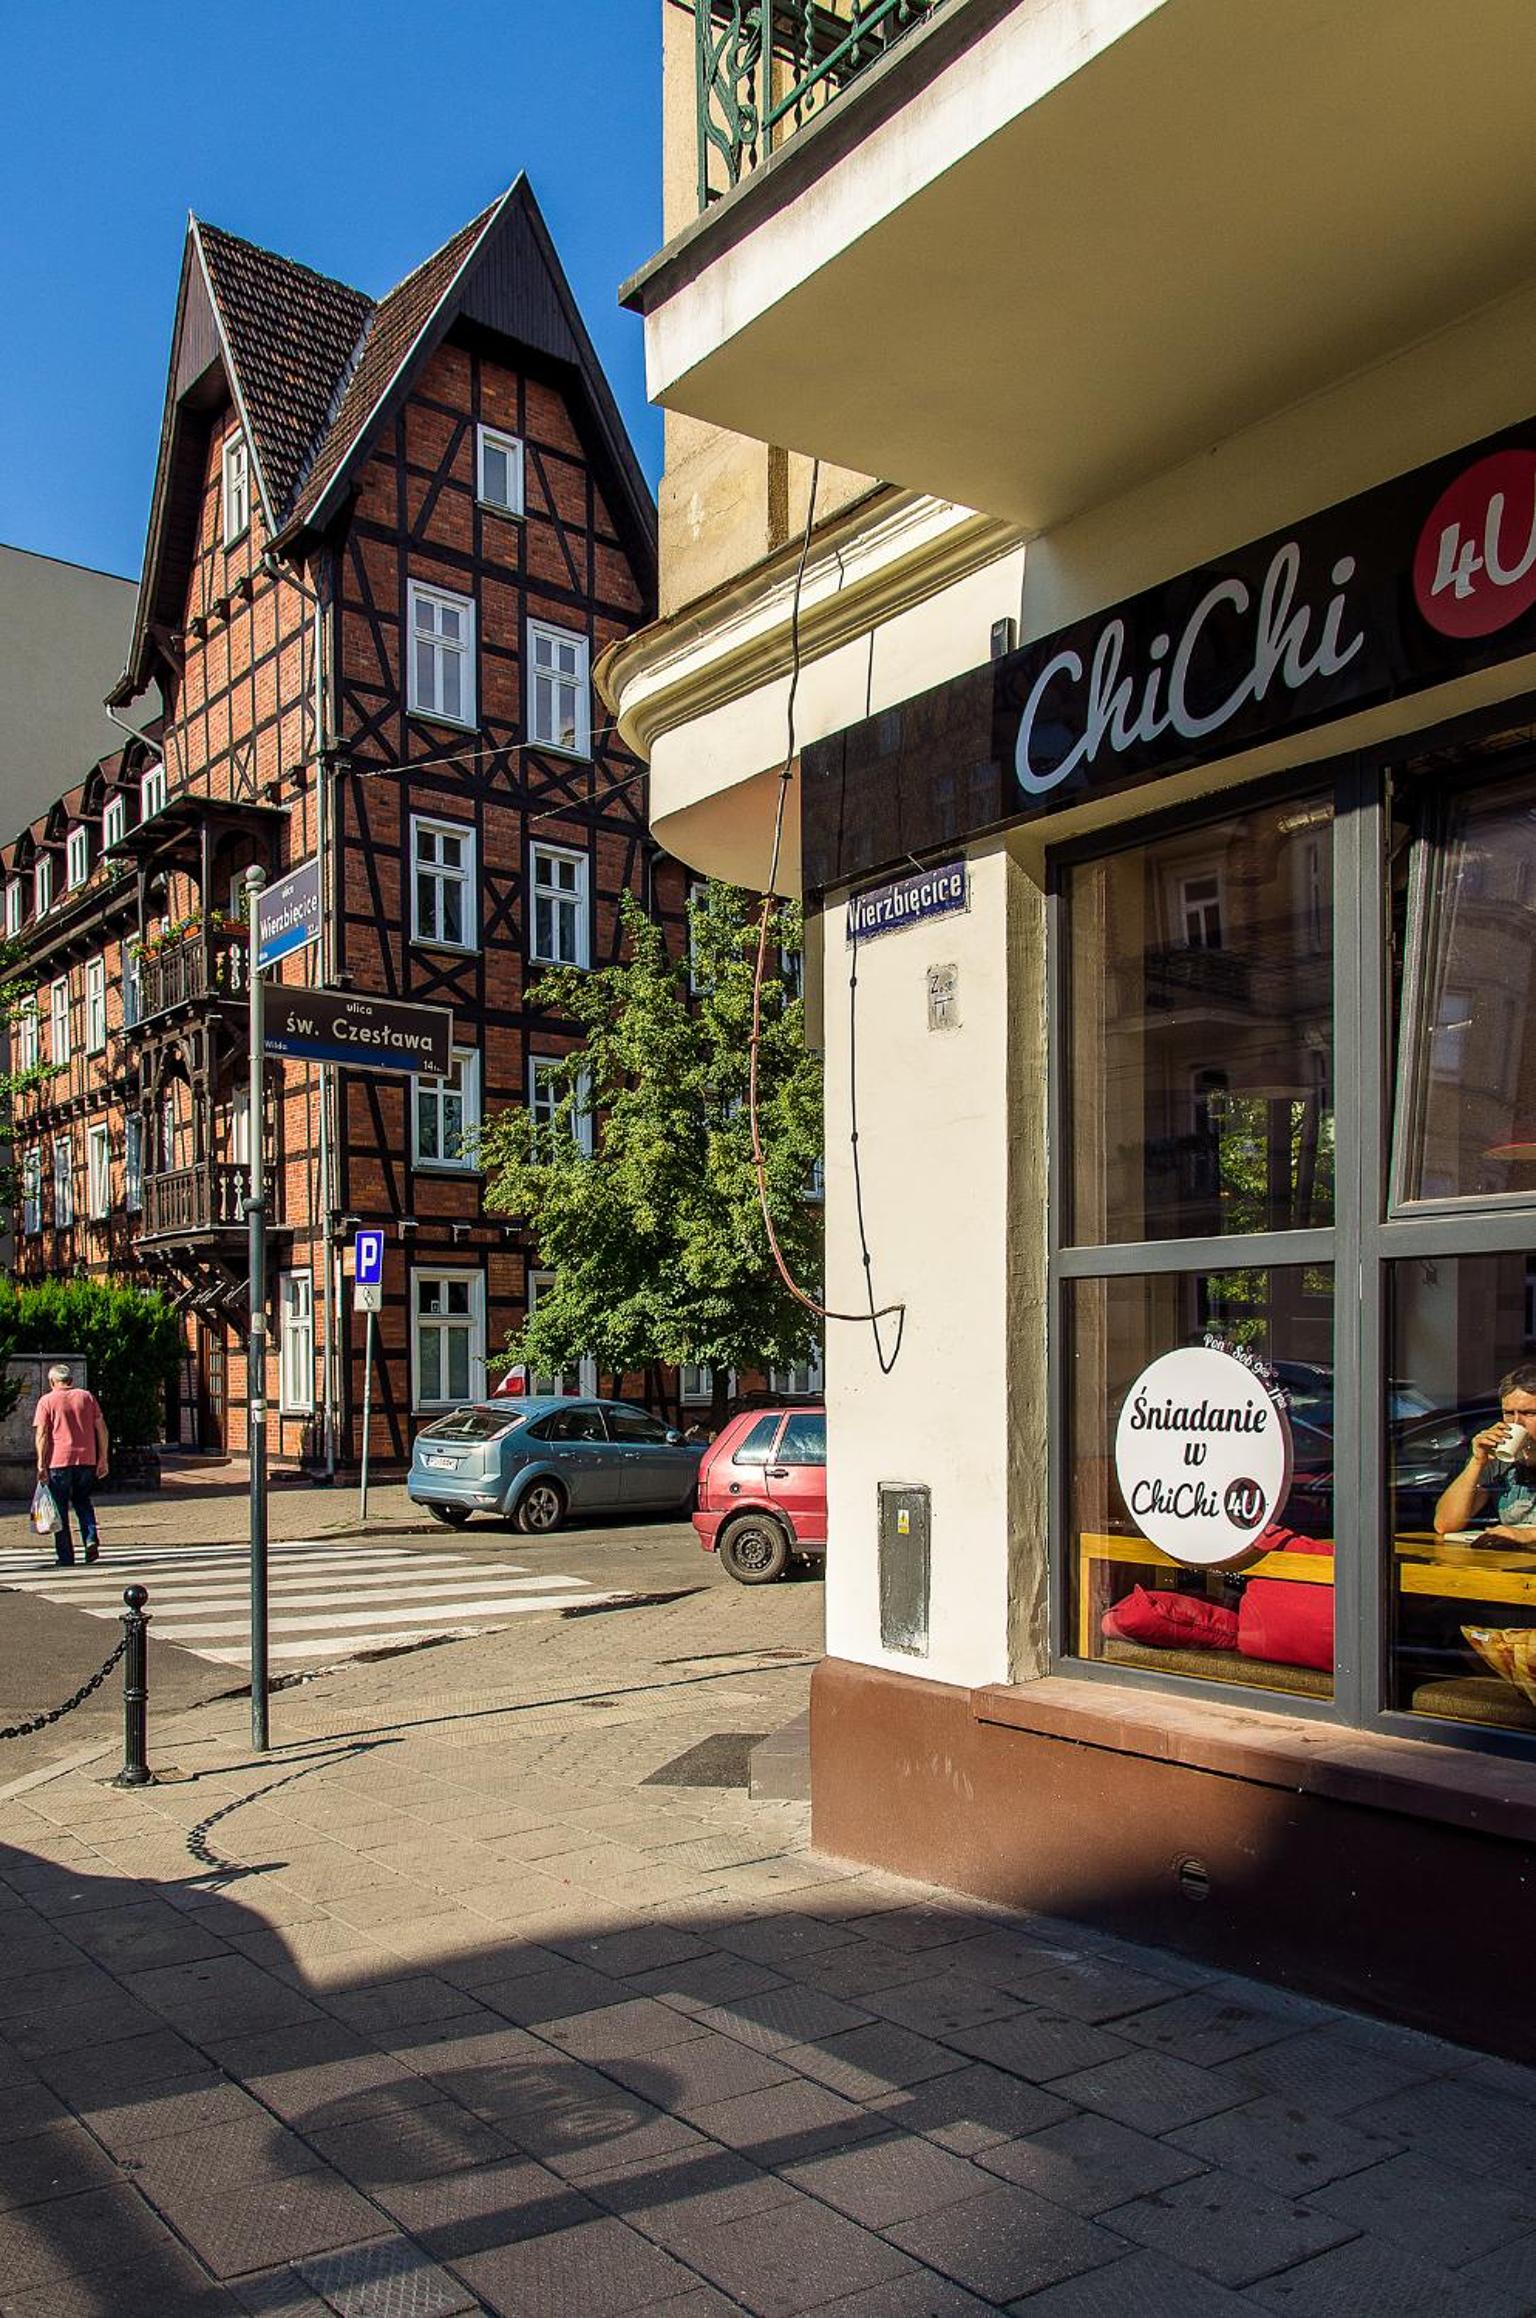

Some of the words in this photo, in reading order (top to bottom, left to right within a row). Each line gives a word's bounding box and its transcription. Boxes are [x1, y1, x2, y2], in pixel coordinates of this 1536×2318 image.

[1015, 541, 1364, 795] ChiChi
[1431, 470, 1536, 599] 4U
[346, 1002, 373, 1015] ulica
[286, 1011, 319, 1036] św.
[331, 1017, 433, 1052] Czesława
[361, 1237, 378, 1278] P
[1130, 1386, 1268, 1433] Śniadanie
[1183, 1443, 1207, 1466] w
[1131, 1479, 1220, 1519] ChiChi
[1227, 1488, 1261, 1520] 4U
